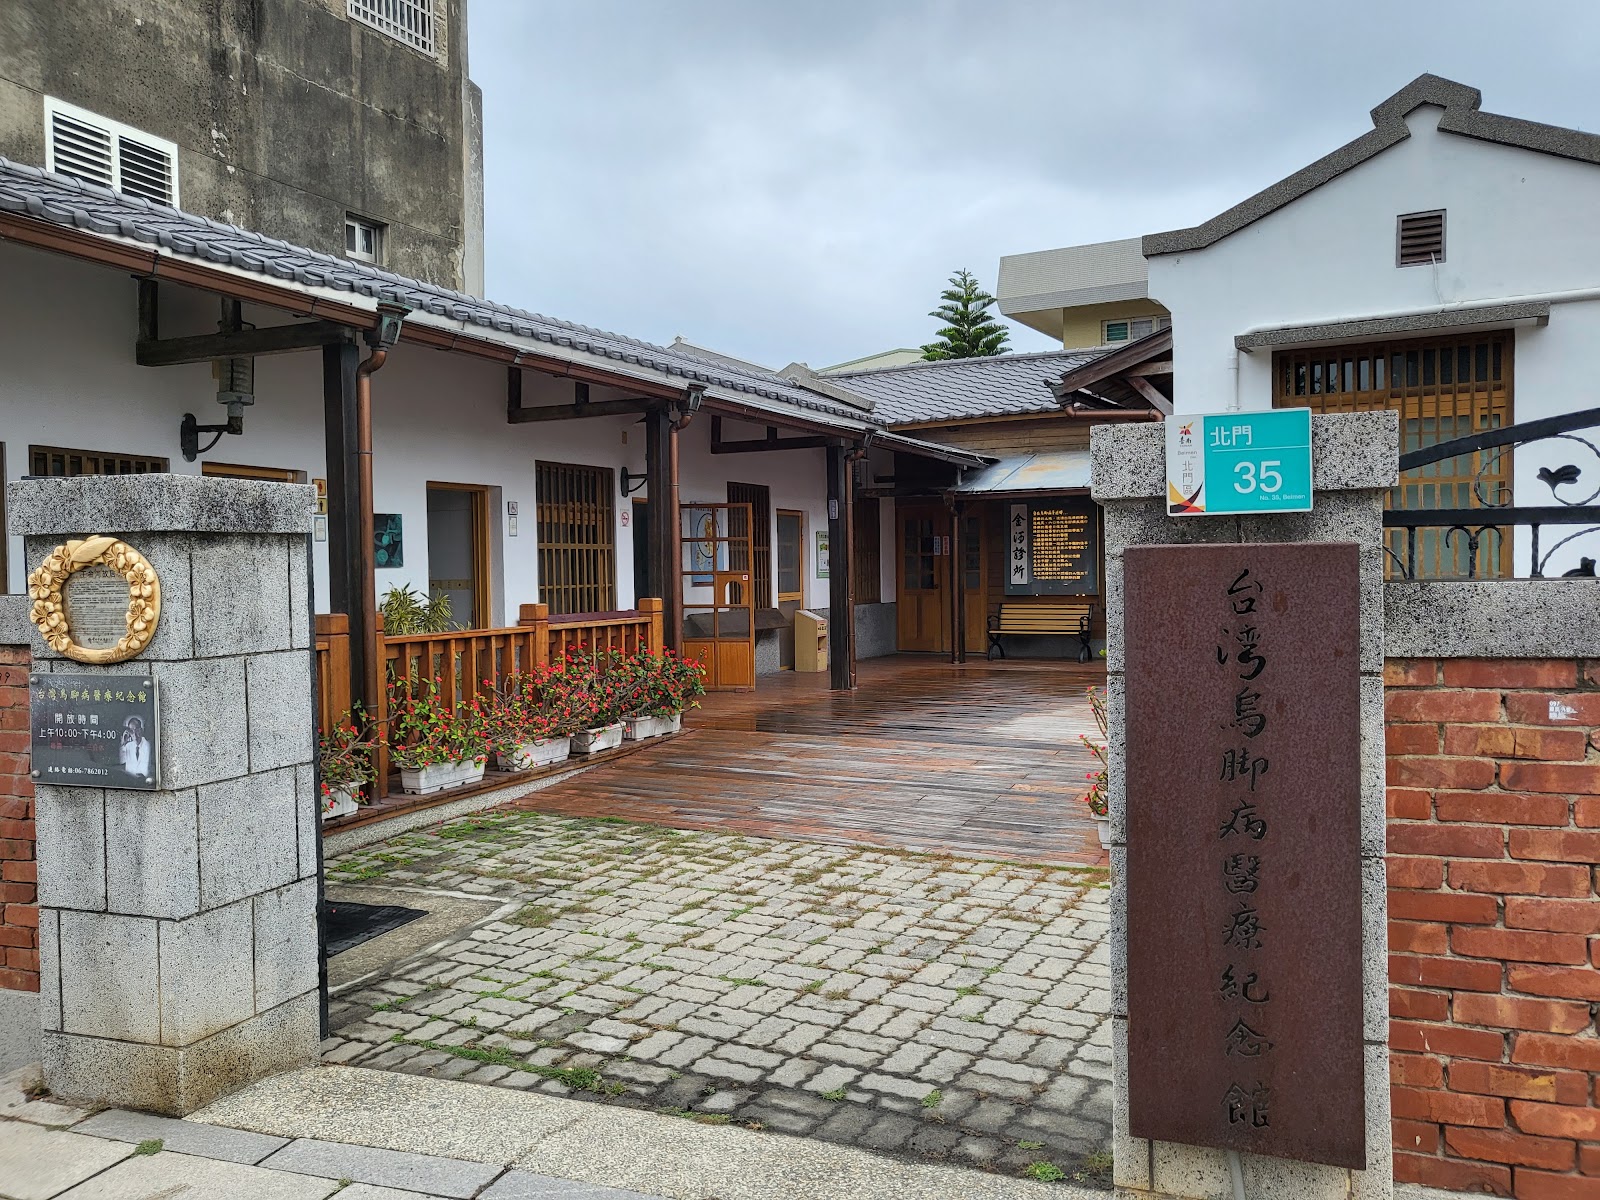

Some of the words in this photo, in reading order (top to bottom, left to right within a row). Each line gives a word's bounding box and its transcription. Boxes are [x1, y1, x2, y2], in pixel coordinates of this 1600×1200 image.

[1210, 425, 1252, 447] 北門
[1182, 460, 1194, 496] 北門區
[1233, 460, 1283, 494] 35
[1011, 512, 1027, 580] 金河診所
[54, 712, 99, 726] 開放時間
